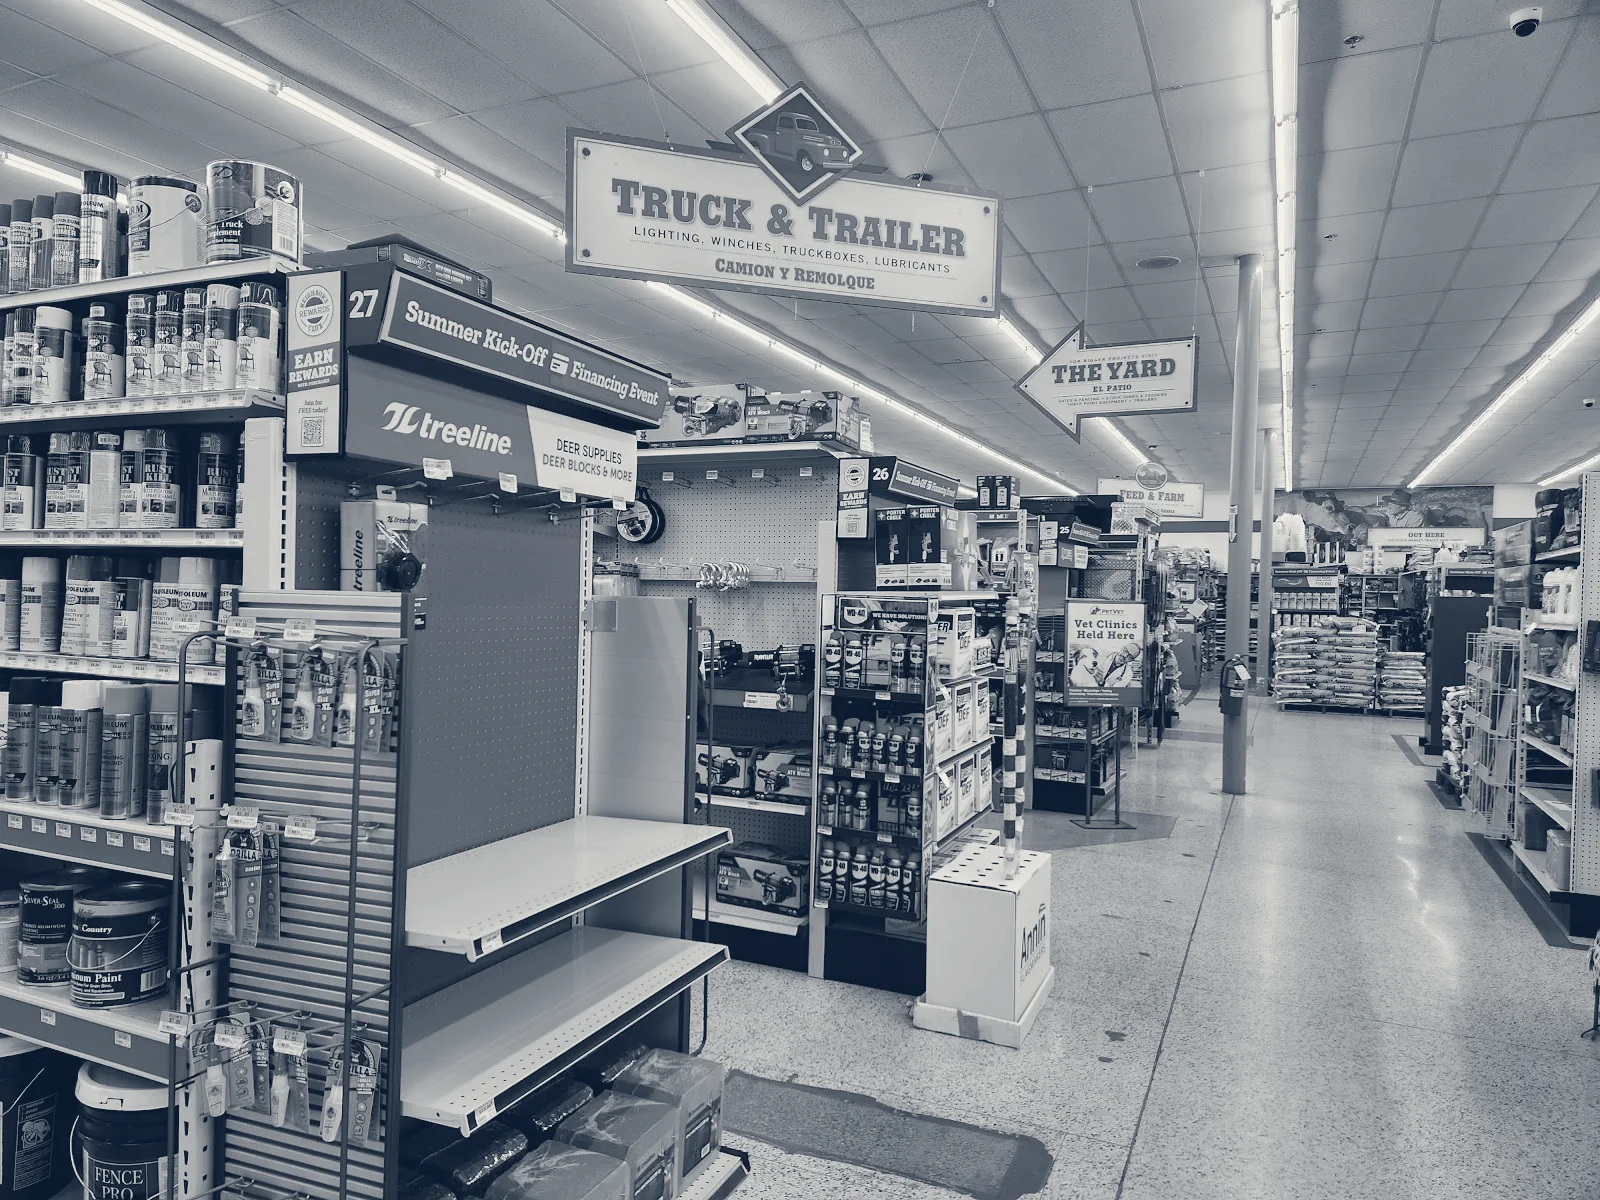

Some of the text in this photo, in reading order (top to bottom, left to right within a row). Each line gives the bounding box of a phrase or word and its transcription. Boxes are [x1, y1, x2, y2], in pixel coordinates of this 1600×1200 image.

[221, 220, 244, 228] Truck
[611, 178, 967, 257] TRUCK & TRAILER
[211, 228, 241, 238] plement
[633, 226, 951, 274] LIGHTING, WINCHES, TRUCKBOXES, LUBRICANTS
[714, 258, 875, 290] CAMION Y REMOLQUE
[349, 289, 379, 319] 27
[299, 305, 331, 318] REWARDS
[294, 348, 334, 369] EARN
[404, 301, 659, 407] Summer Kick-Off Financing Event
[289, 364, 339, 384] REWARDS
[1052, 358, 1176, 384] THE YARD
[1106, 384, 1132, 392] PATIO
[418, 412, 513, 456] treeline
[556, 438, 623, 465] DEER SUPPLIES
[70, 466, 81, 474] ST
[122, 465, 134, 474] ST
[145, 464, 174, 474] RUST
[542, 453, 633, 483] DEER BLOCKS & MORE
[872, 467, 889, 481] 26
[146, 473, 172, 482] KILL
[842, 492, 865, 500] EARN
[1120, 489, 1185, 502] FEED & FARM
[840, 498, 867, 507] REWARDS
[1060, 526, 1070, 534] 25
[353, 530, 363, 592] treeline
[846, 608, 866, 617] WD-40
[1074, 619, 1138, 629] Vet Clinics
[1076, 630, 1135, 640] Held Here
[960, 636, 971, 650] DEF
[258, 669, 277, 679] RILLA
[311, 673, 331, 685] RILLA
[270, 698, 280, 706] XL
[369, 706, 380, 714] XL
[958, 706, 970, 722] DEF
[938, 713, 950, 730] DEF
[149, 753, 170, 761] XING
[231, 849, 257, 860] ORILLA
[23, 894, 60, 907] SILVER-SEAL
[81, 924, 113, 934] Country
[1020, 914, 1046, 969] Annin
[95, 973, 122, 983] Paint
[95, 1166, 144, 1185] FENCE
[102, 1186, 134, 1200] PRO
